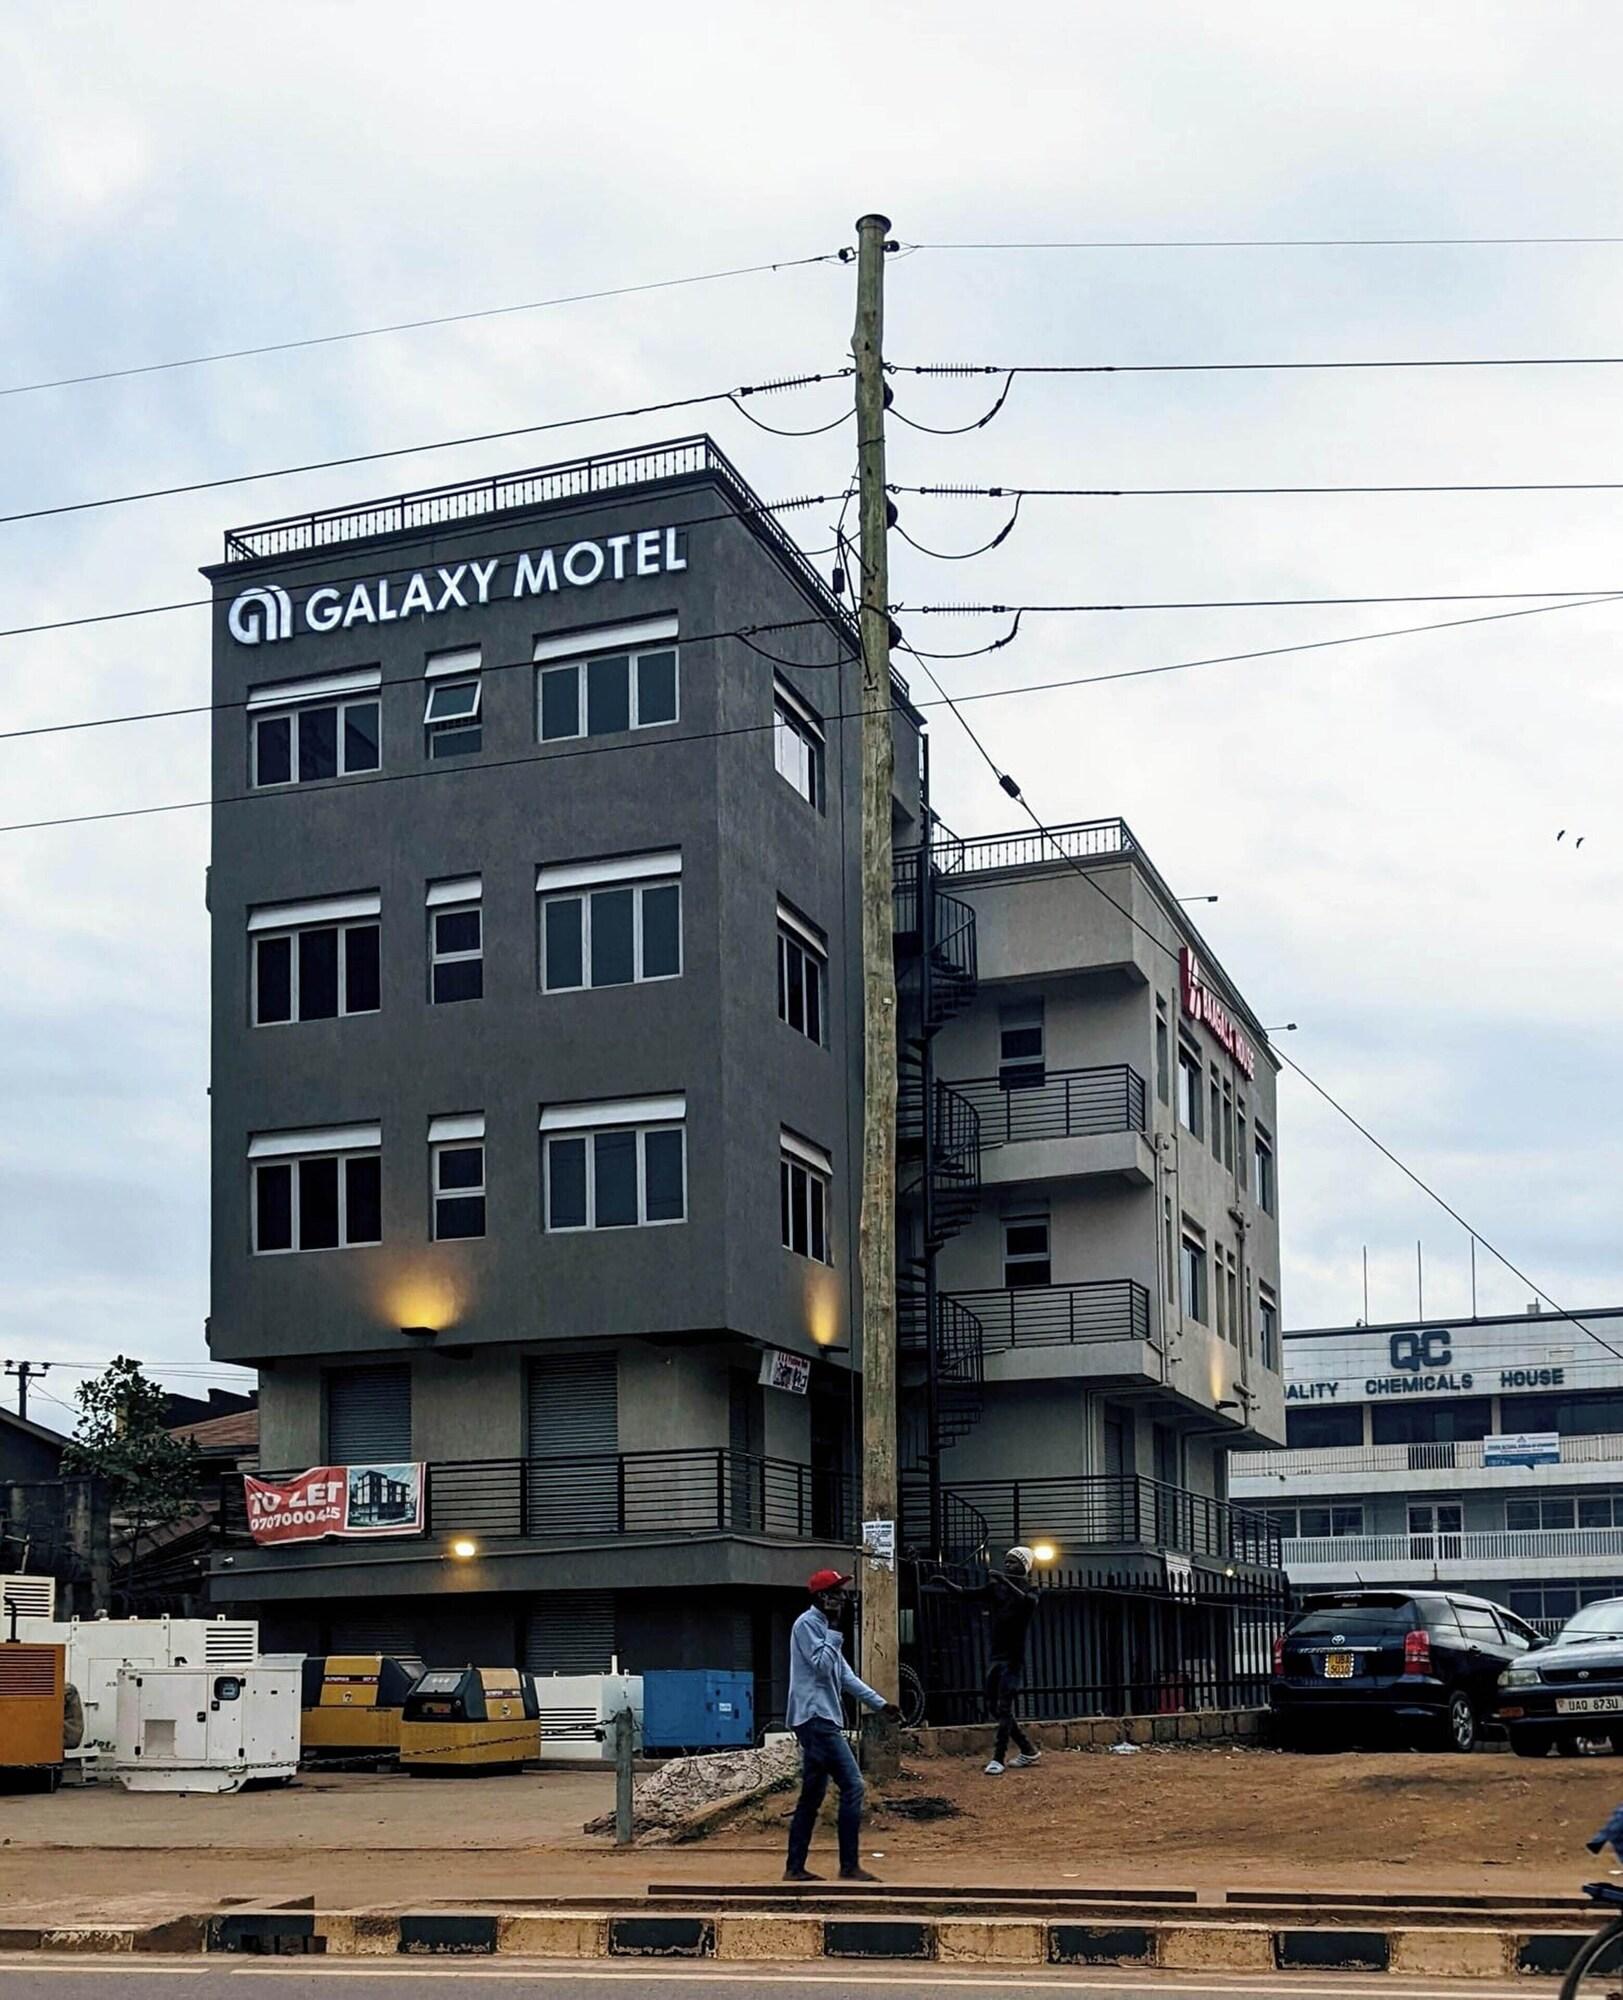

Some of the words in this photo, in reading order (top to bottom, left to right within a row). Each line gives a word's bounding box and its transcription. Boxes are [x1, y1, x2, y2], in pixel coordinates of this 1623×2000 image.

[305, 558, 499, 632] GALAXY
[513, 526, 688, 598] MOTEL
[1390, 1329, 1453, 1372] QC
[1284, 1381, 1339, 1400] ALITY
[1365, 1373, 1473, 1395] CHEMICALS
[1501, 1368, 1564, 1388] HOUSE
[250, 1490, 283, 1515] TO
[288, 1481, 344, 1508] LET
